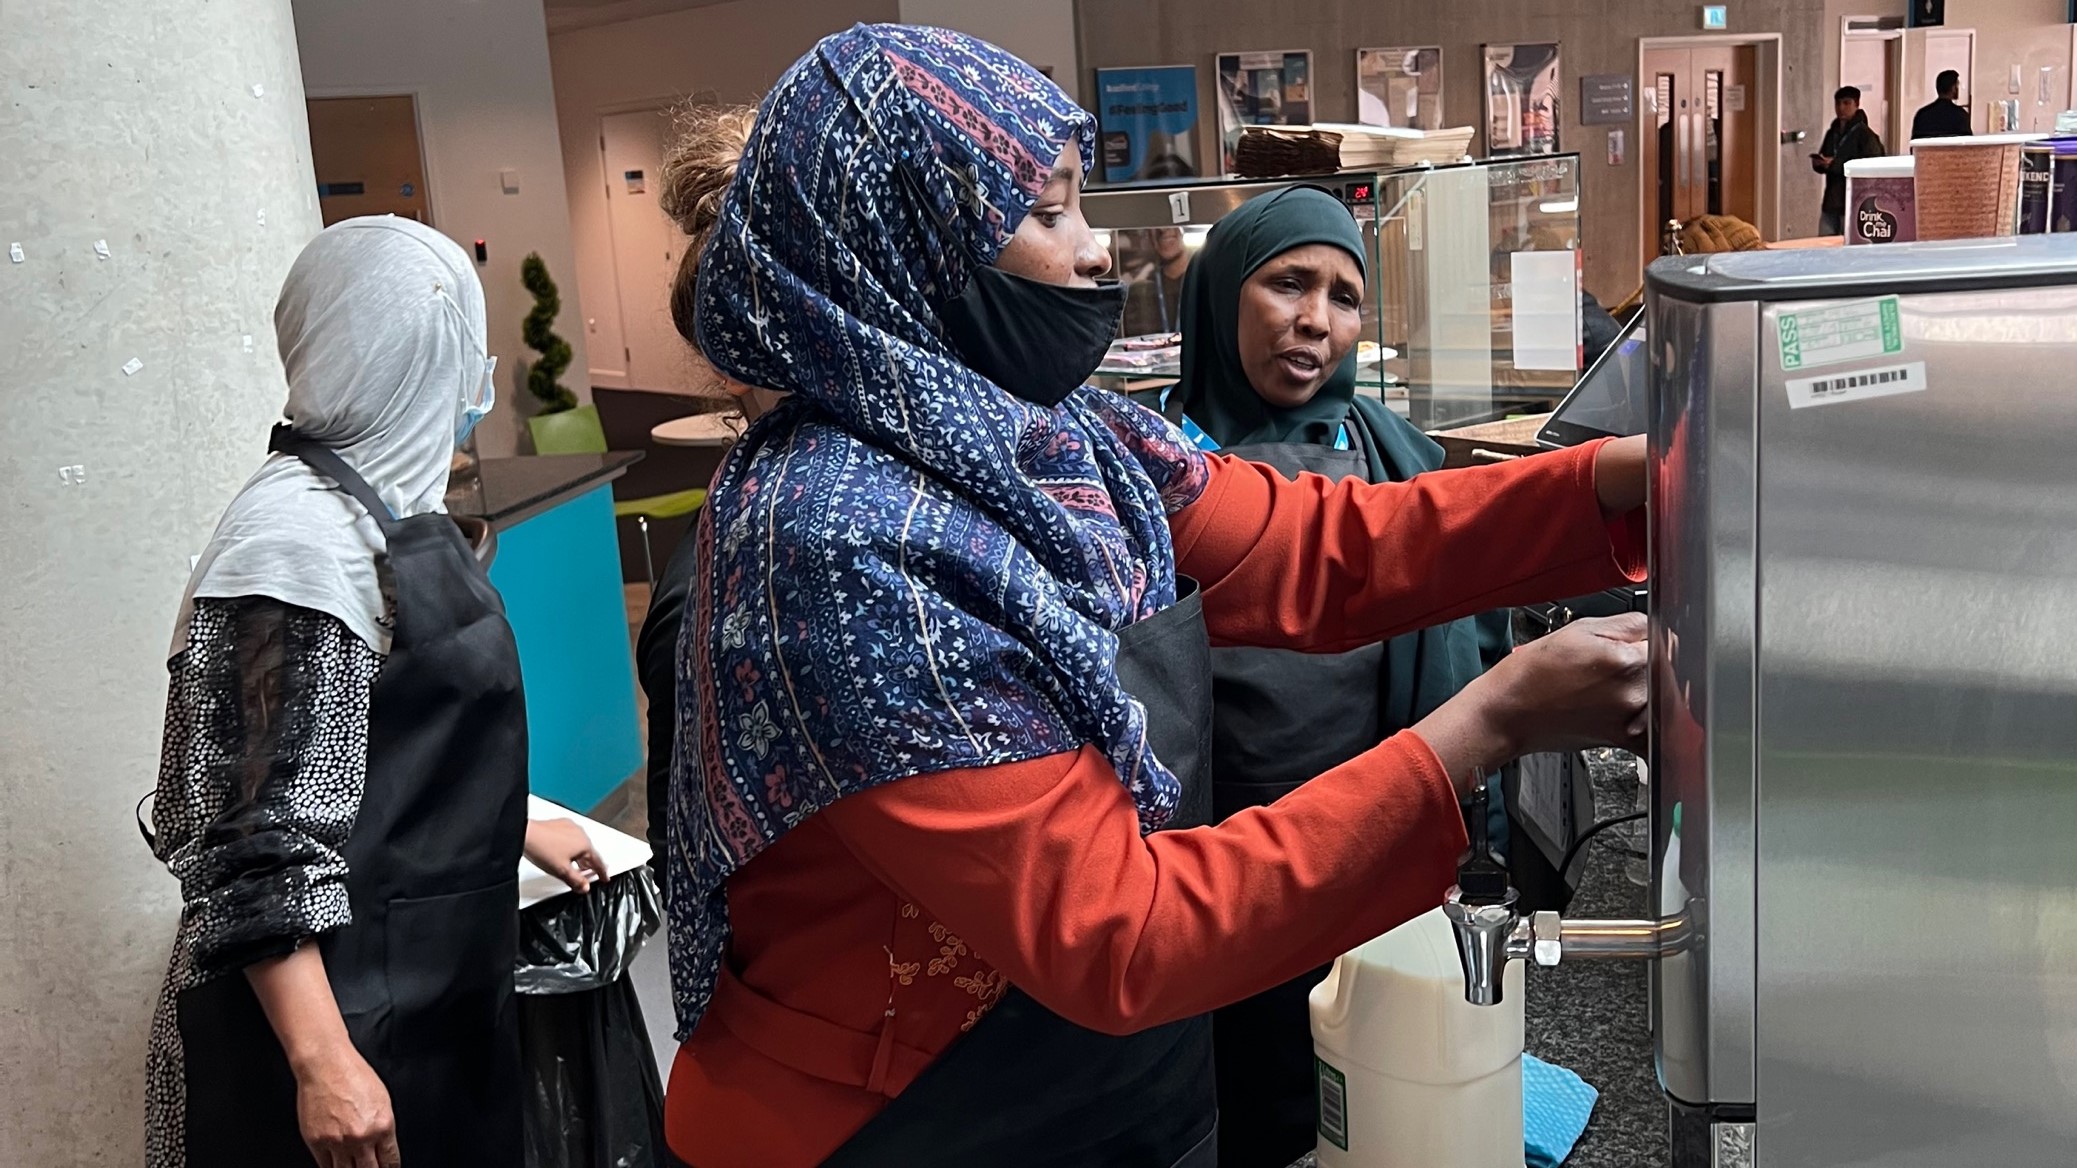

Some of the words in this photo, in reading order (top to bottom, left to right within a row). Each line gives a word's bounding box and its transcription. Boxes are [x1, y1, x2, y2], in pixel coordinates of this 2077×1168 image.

[1176, 198, 1185, 217] 1
[1860, 209, 1885, 222] Drink
[1780, 314, 1800, 367] PASS
